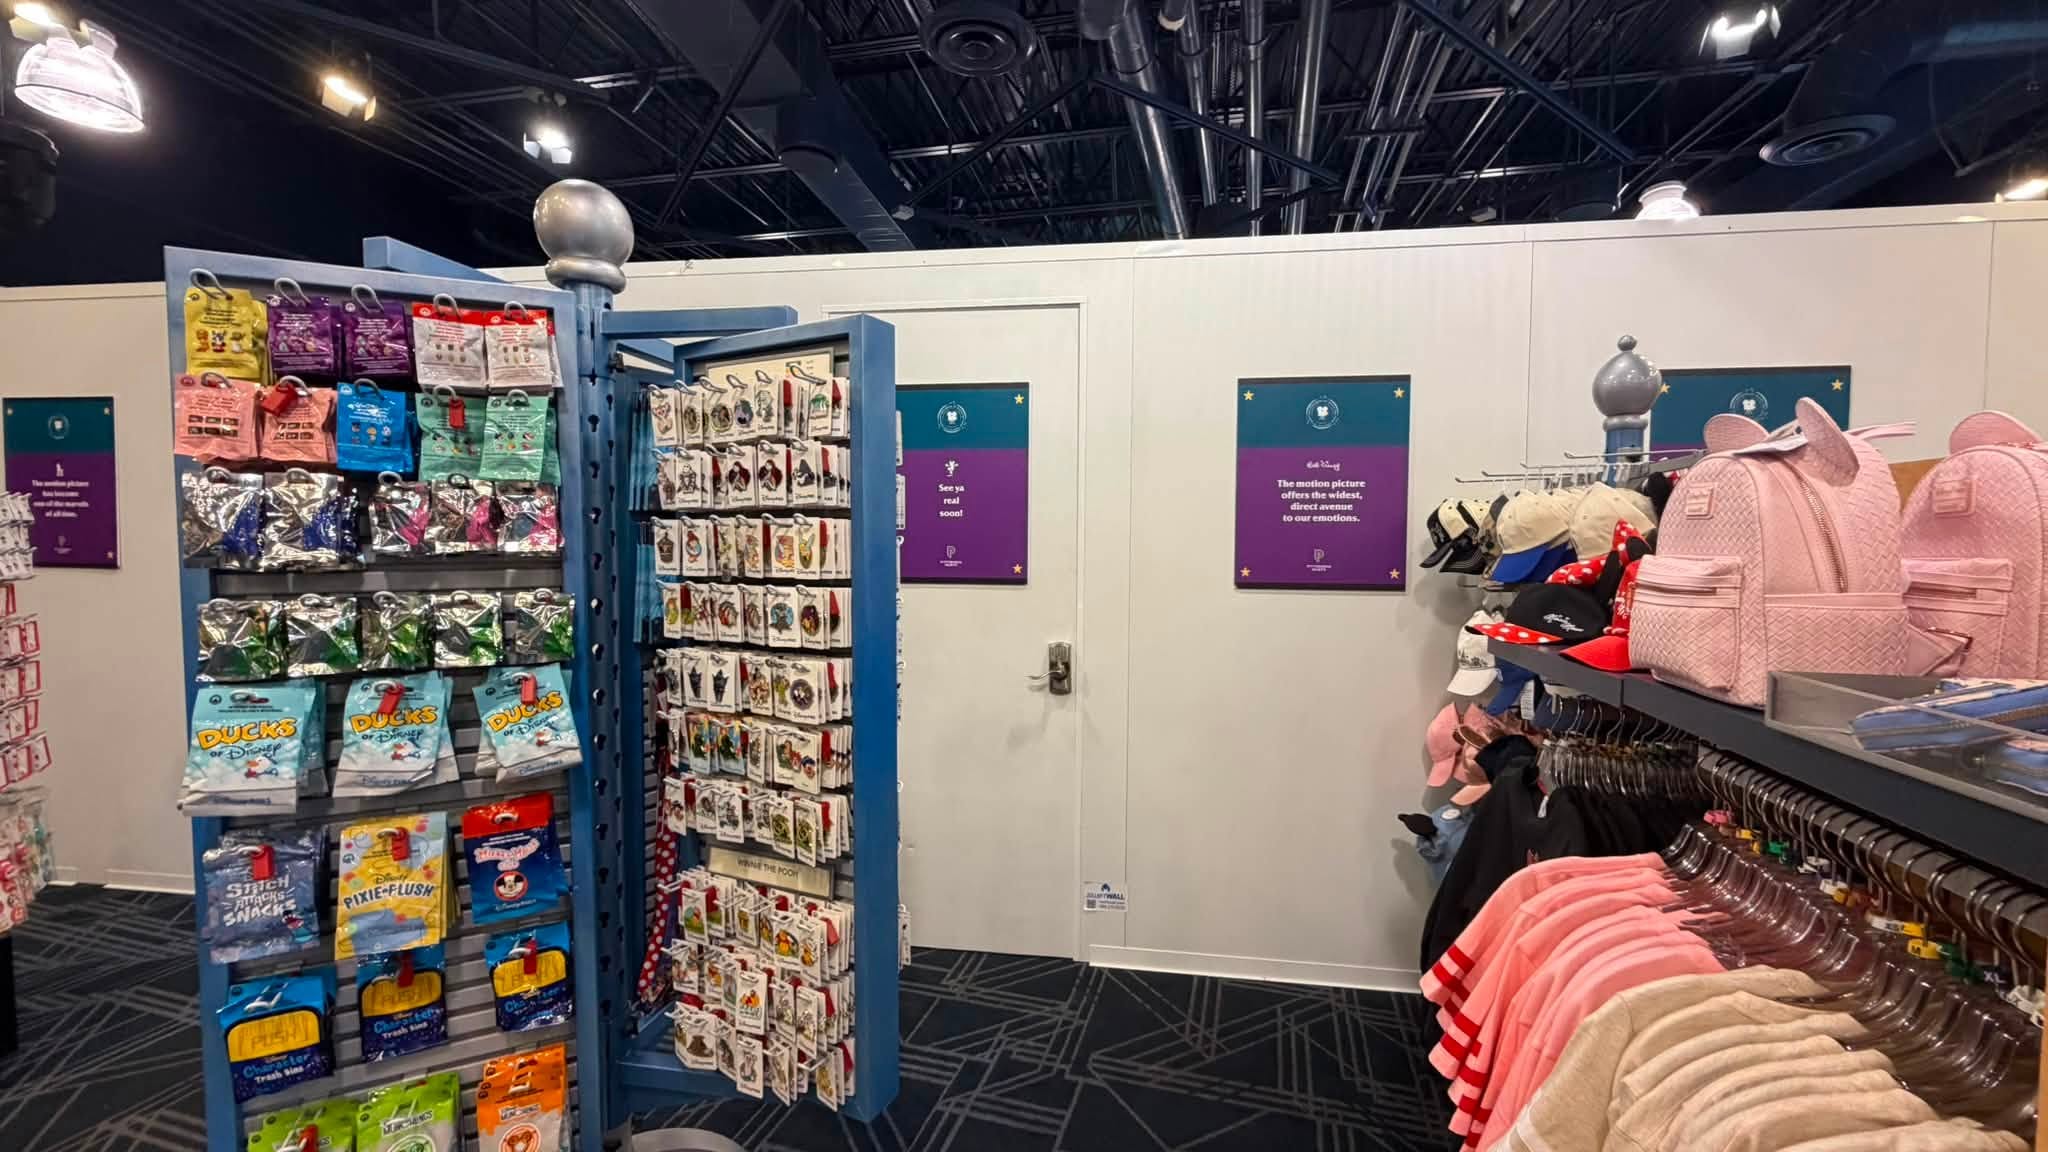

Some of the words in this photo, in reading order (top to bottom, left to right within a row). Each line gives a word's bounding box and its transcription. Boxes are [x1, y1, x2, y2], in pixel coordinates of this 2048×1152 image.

[938, 483, 954, 493] See
[954, 485, 965, 494] ya
[1277, 479, 1295, 488] The
[1296, 479, 1330, 488] motion
[1331, 479, 1366, 489] picture
[943, 496, 960, 505] real
[1281, 490, 1310, 499] offers
[1311, 490, 1327, 499] the
[1328, 490, 1363, 500] widest,
[939, 508, 963, 518] soon!
[1290, 502, 1318, 511] direct
[1319, 503, 1353, 511] avenue
[1283, 514, 1293, 522] to
[1312, 513, 1361, 522] emotions.
[487, 690, 564, 732] DUCKS
[350, 705, 438, 734] DUCKS
[197, 717, 297, 751] DUCKS
[763, 863, 776, 874] THE
[777, 866, 800, 878] POOH
[225, 874, 290, 898] STITCH
[234, 890, 286, 912] ATTACKS
[223, 899, 297, 927] SNACKS
[1983, 970, 2007, 984] XL
[243, 1054, 311, 1078] Character
[255, 1072, 283, 1084] Trash
